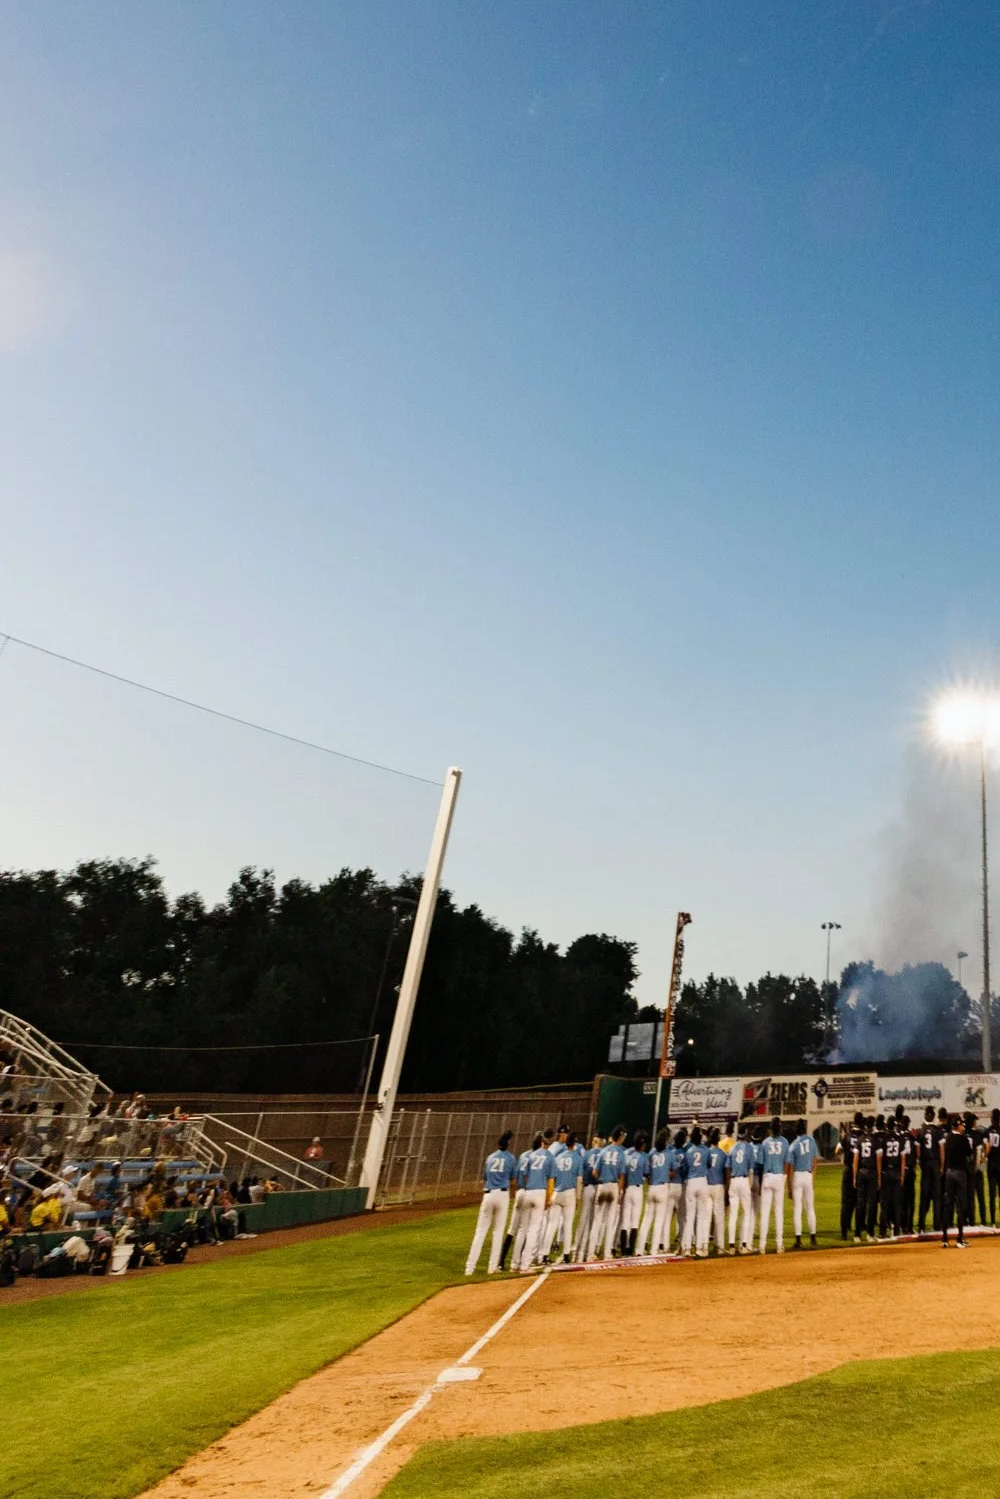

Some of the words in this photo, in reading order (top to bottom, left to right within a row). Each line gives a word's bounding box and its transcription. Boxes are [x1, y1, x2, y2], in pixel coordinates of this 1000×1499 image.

[770, 1082, 808, 1101] ZIEMS
[768, 1141, 782, 1155] 33
[886, 1141, 900, 1157] 23
[490, 1158, 506, 1173] 21
[530, 1155, 548, 1170] 27
[603, 1151, 618, 1165] 44
